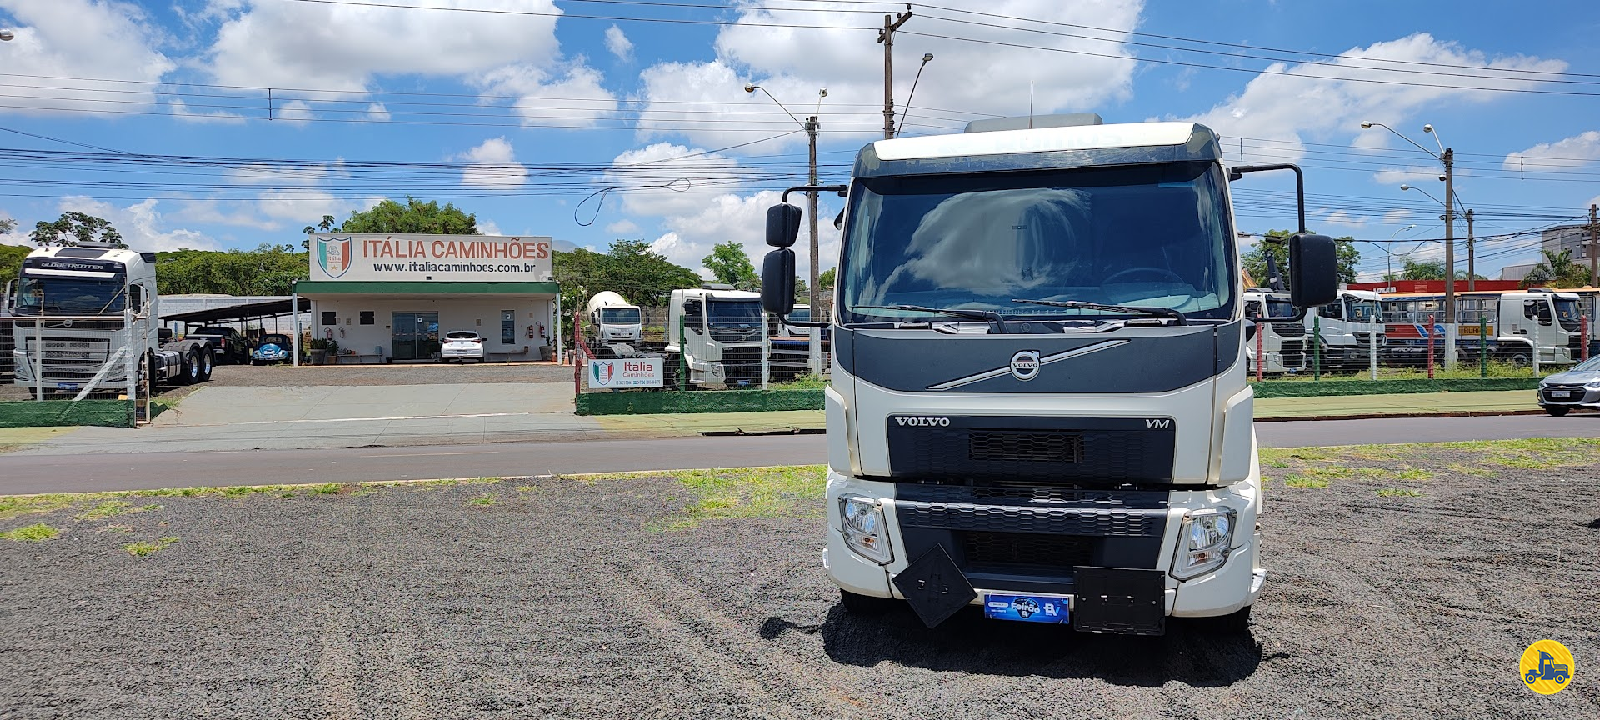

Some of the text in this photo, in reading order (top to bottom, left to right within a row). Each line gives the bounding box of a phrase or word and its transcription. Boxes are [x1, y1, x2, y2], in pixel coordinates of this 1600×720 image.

[363, 236, 549, 259] ITÁLIA CAMINHÕES
[373, 262, 536, 273] www.italiacaminhoes.com.br
[894, 416, 950, 427] VOLVO
[1145, 419, 1170, 429] VM
